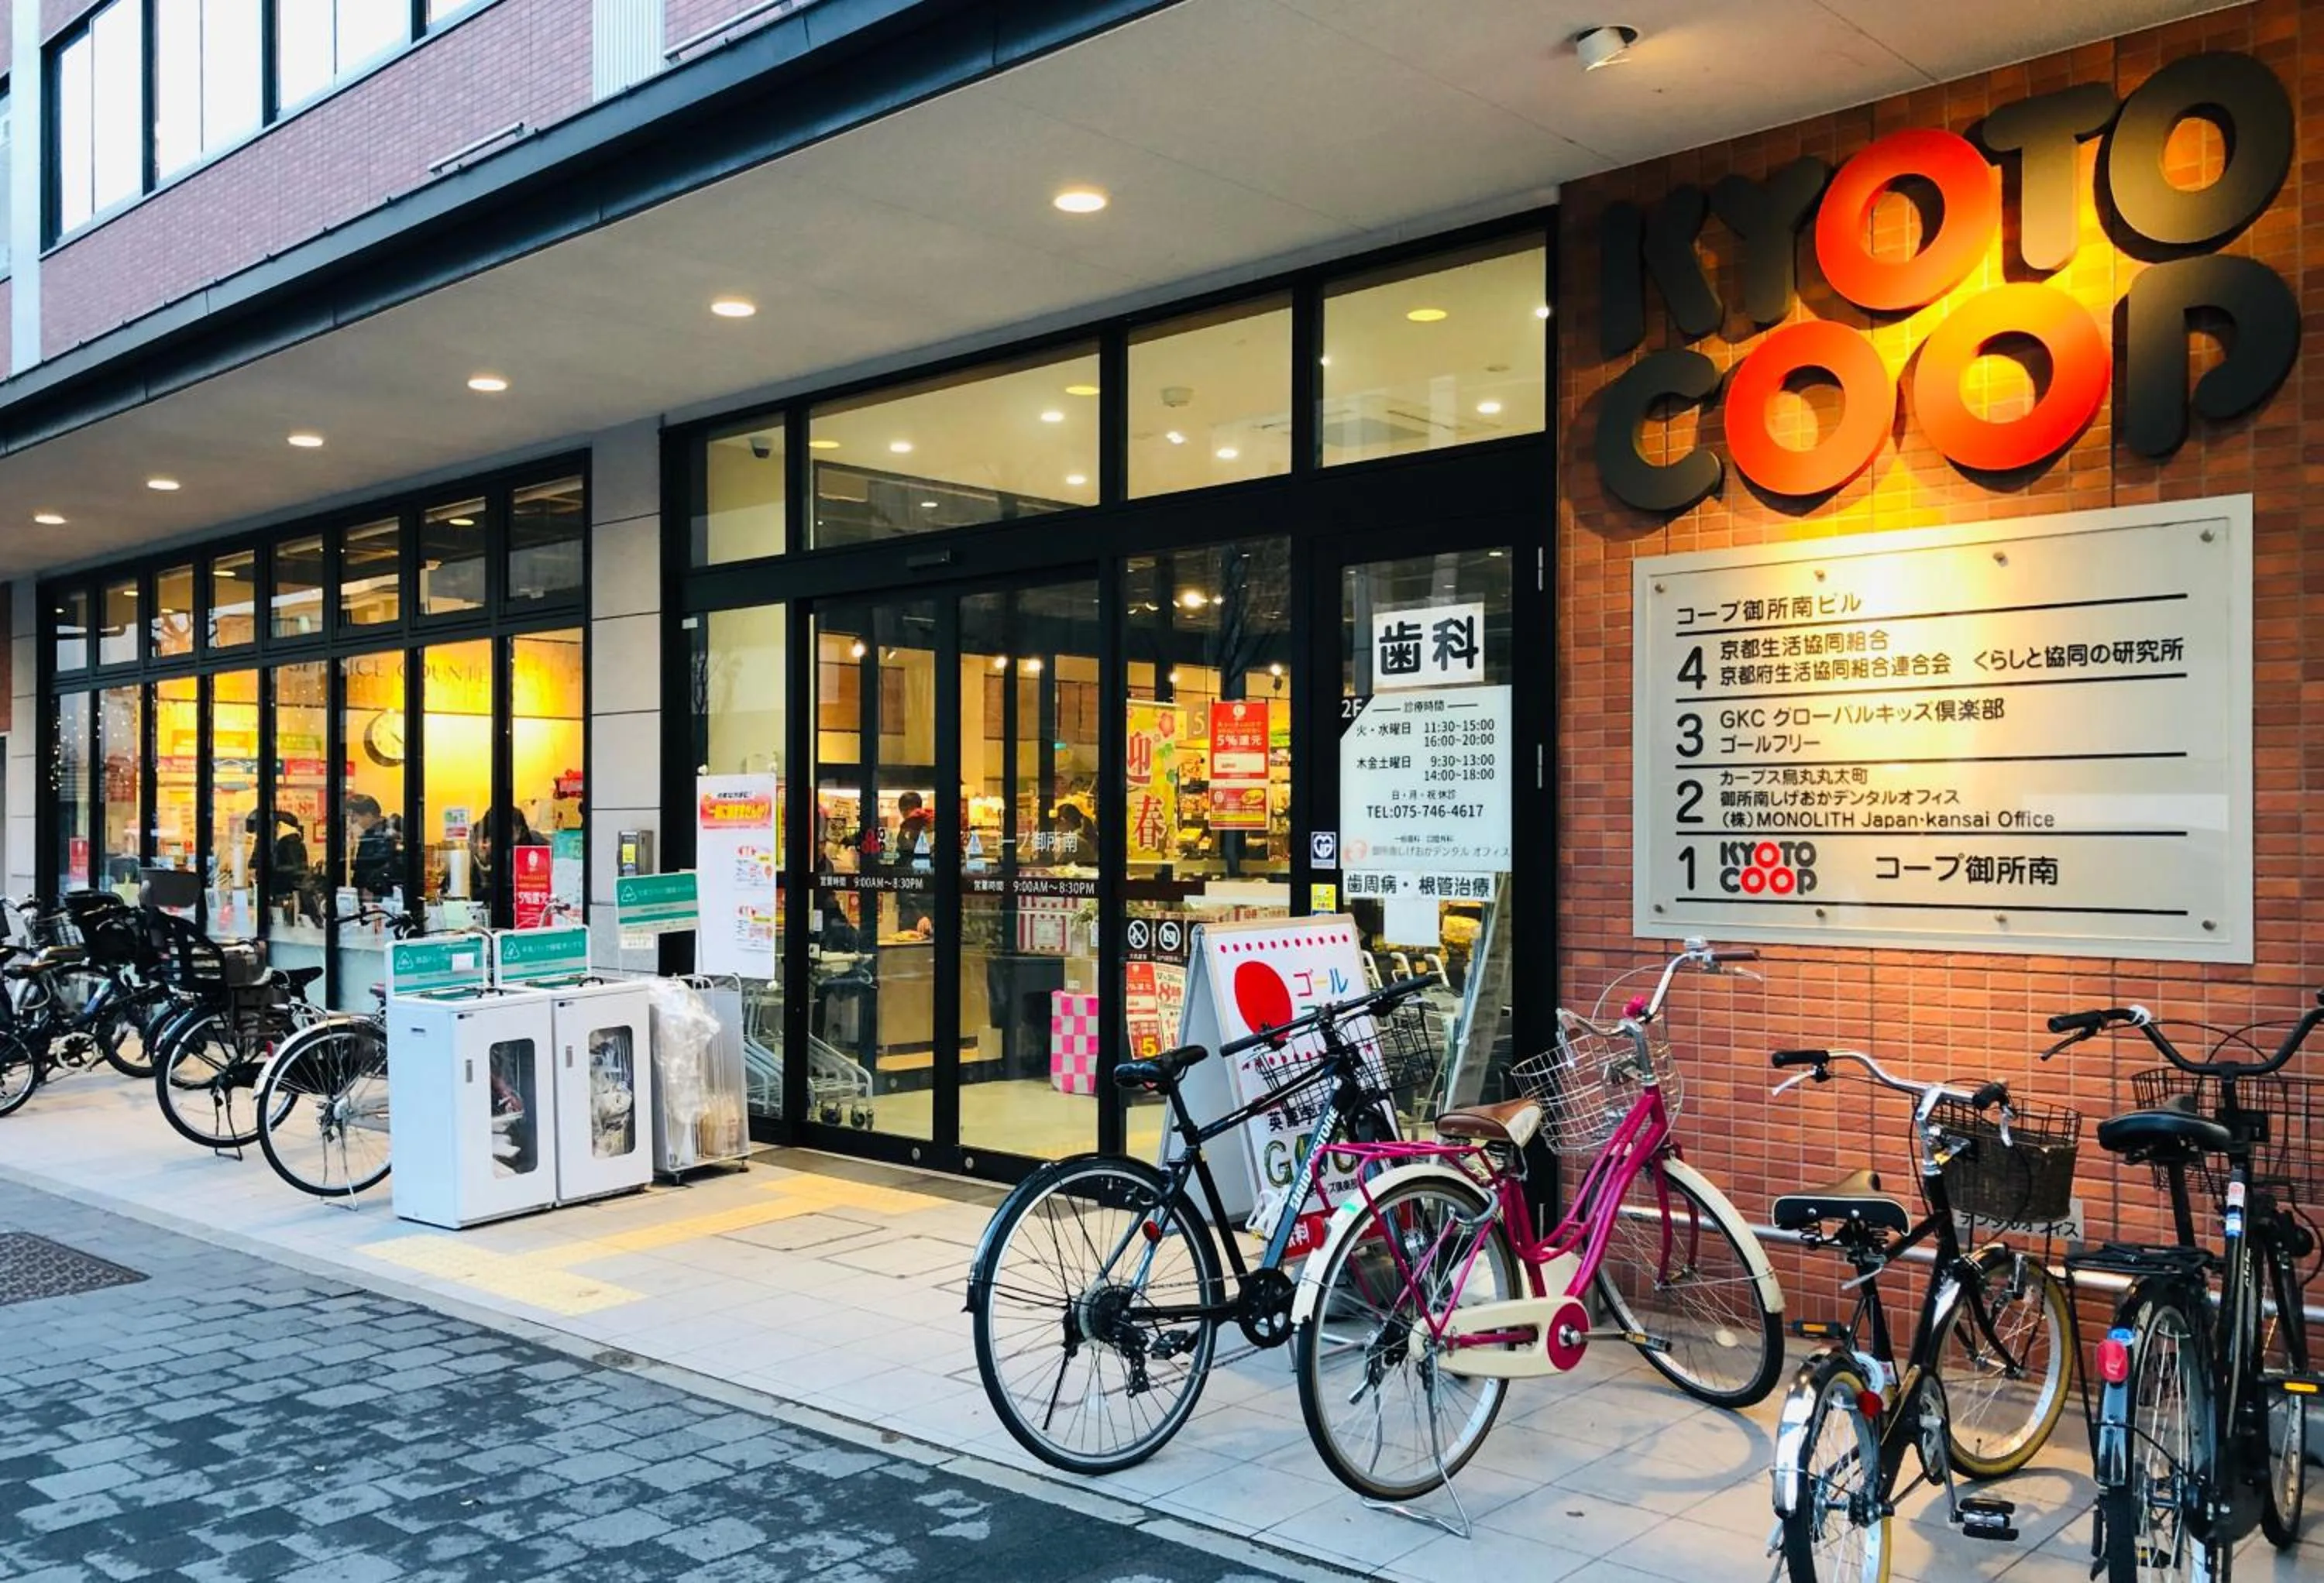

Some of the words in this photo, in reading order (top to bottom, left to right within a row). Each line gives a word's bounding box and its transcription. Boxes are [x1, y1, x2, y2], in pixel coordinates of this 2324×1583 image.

[1598, 51, 2295, 359] KYOTO
[1595, 253, 2301, 512] COOP
[1677, 594, 1862, 625] コープ御所南ビル
[1379, 616, 1479, 675] 歯科
[1720, 630, 1889, 661] 京都生活協同組合
[1677, 645, 1707, 690] 4
[1720, 653, 1951, 686] 京都府生活協同組合連合会
[1973, 637, 2185, 671] くらしと協同の研究所
[1341, 698, 1363, 718] 2F
[1720, 708, 1765, 730] GKC
[1772, 698, 2005, 726] グローバルキッズ倶楽部
[1676, 713, 1703, 758] 3
[1720, 733, 1820, 754] ゴールフリー
[1356, 755, 1411, 770] 木金土曜日
[1367, 805, 1484, 819] TEL:075-746-4617
[1676, 779, 1703, 823] 2
[1720, 789, 1960, 808] 御所南しげおかデンタルオフィス
[1998, 811, 2055, 828] Office
[1679, 845, 1695, 891] 1
[1720, 840, 1817, 869] KYOTO
[1875, 853, 2058, 886] コープ御所南
[1720, 867, 1817, 895] COOP
[1293, 967, 1349, 998] ゴール
